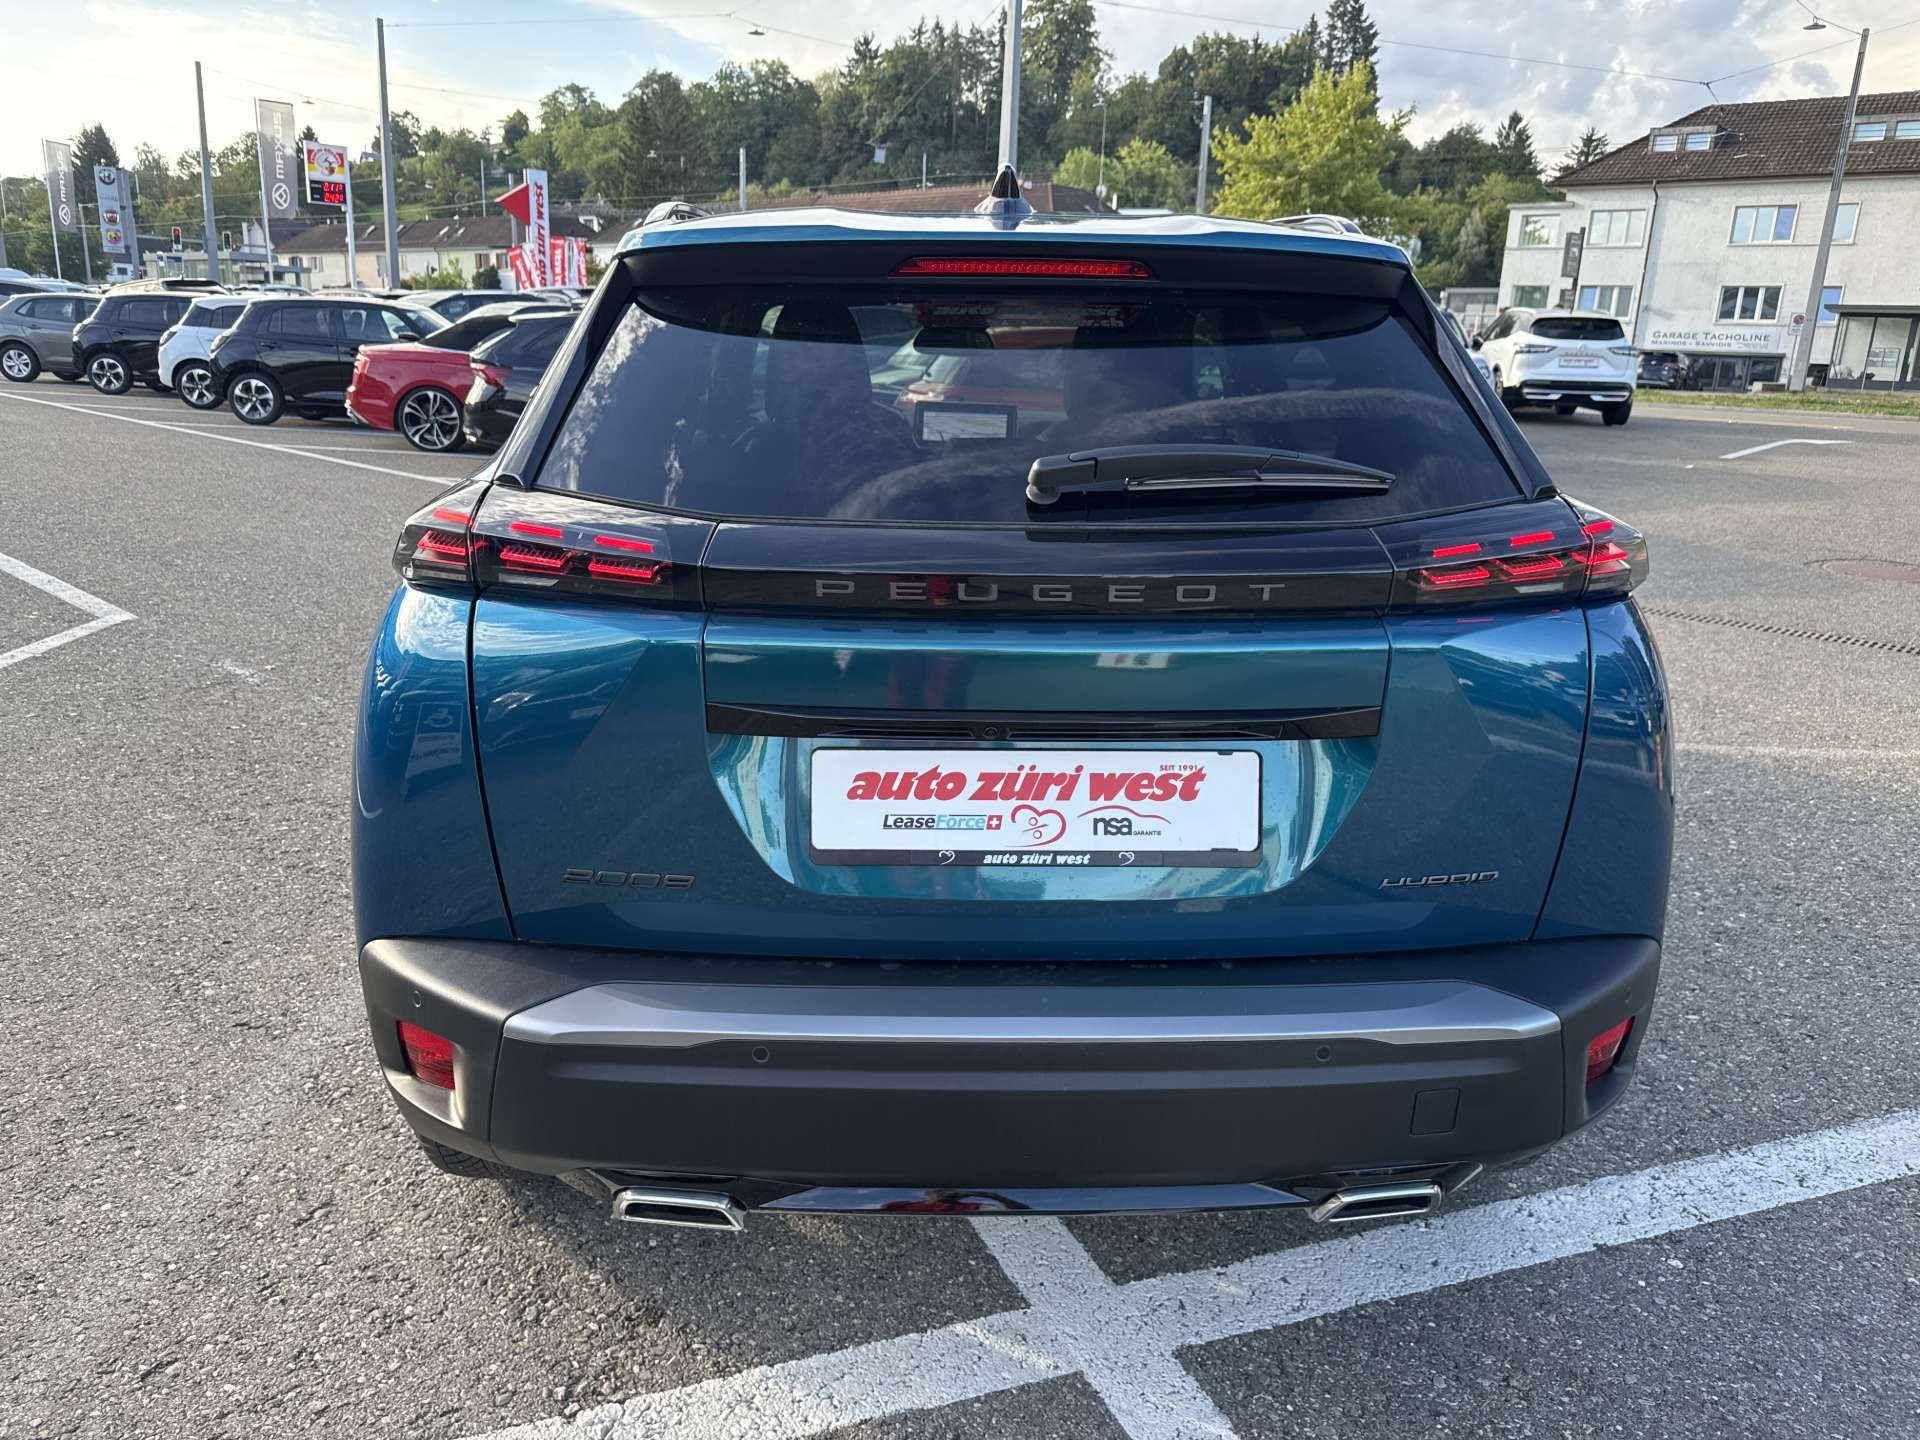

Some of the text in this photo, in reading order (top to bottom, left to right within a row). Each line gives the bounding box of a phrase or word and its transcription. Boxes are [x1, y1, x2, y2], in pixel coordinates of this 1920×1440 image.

[273, 111, 285, 179] MAXUS
[56, 150, 67, 202] MAXUS
[533, 182, 545, 220] west
[1652, 330, 1771, 342] GARAGE TACHOLINE
[815, 579, 1286, 602] PEUGEOT
[1178, 764, 1198, 772] 1991
[846, 764, 1207, 801] auto züri west
[882, 814, 986, 829] LeaseForce
[1092, 817, 1133, 836] nsa
[983, 853, 1091, 864] auto züri west
[560, 868, 696, 889] 2008
